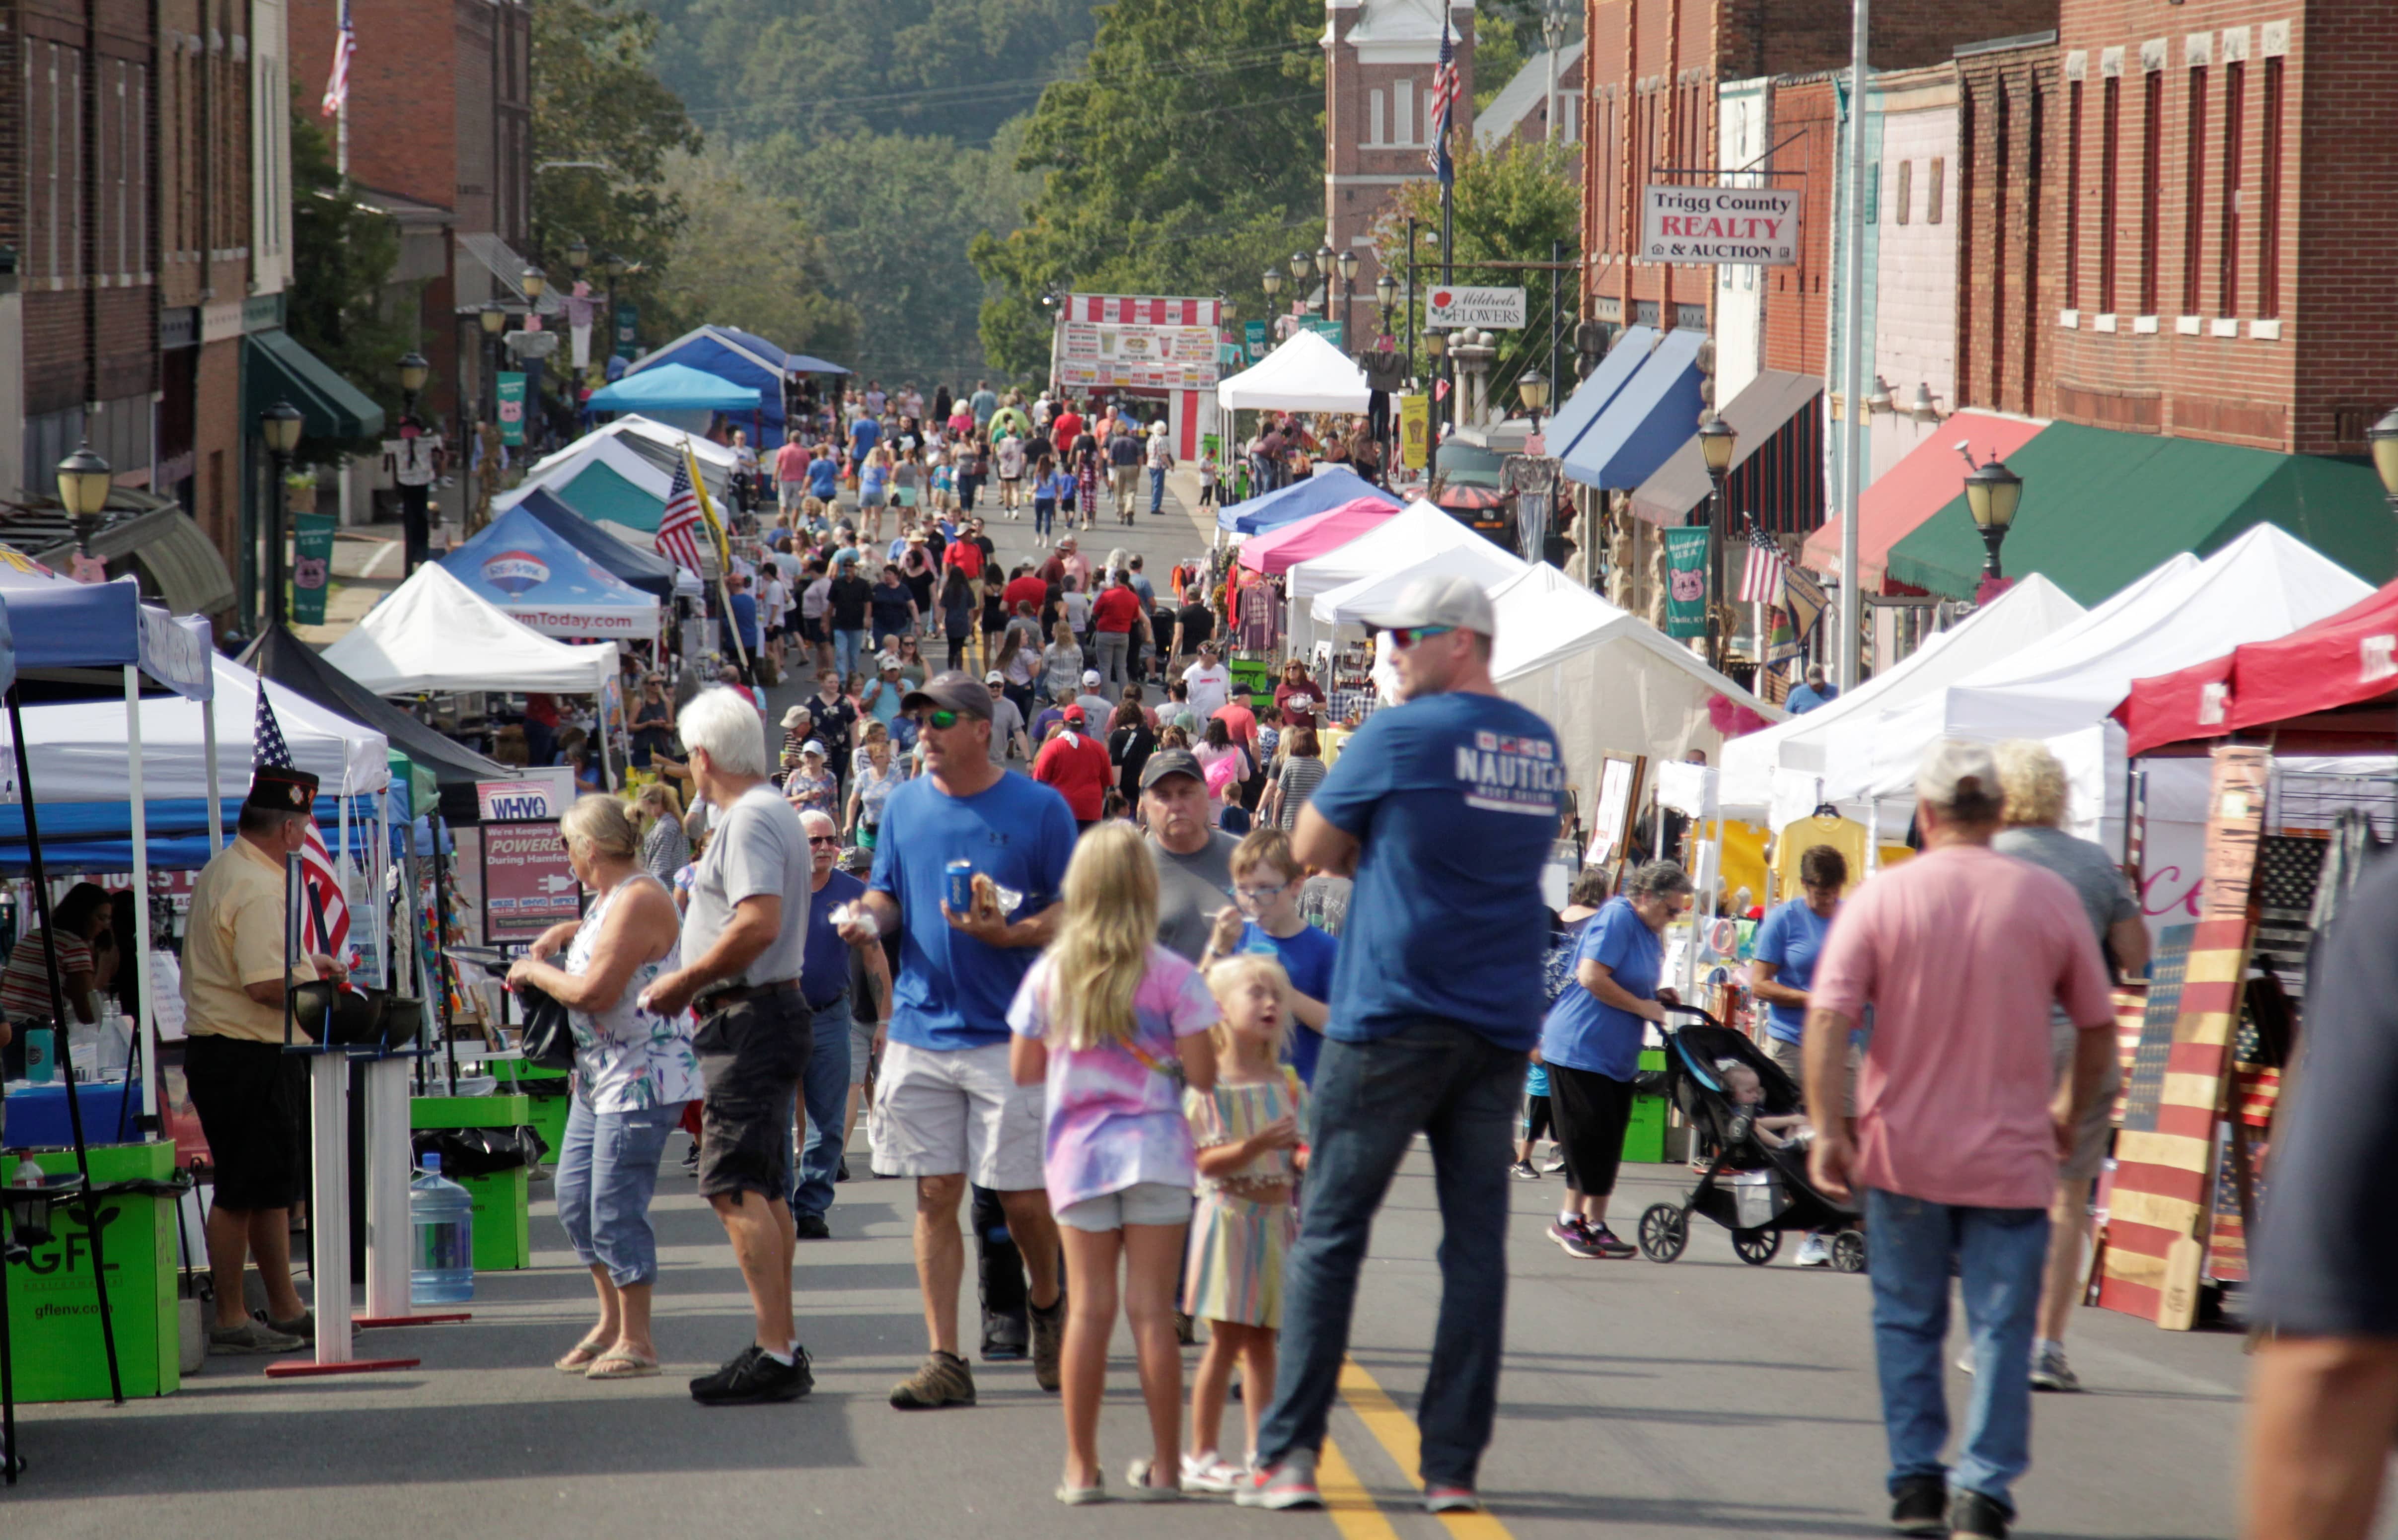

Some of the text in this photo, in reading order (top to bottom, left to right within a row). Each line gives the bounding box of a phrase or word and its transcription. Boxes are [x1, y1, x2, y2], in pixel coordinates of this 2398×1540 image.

[1654, 192, 1791, 215] Trigg County
[1661, 215, 1783, 239] REALTY
[1670, 243, 1686, 255] &
[1689, 243, 1771, 258] AUCTION
[1453, 308, 1520, 323] FLOWERS
[509, 612, 632, 629] rmToday.com
[491, 796, 547, 820] WHVO
[487, 828, 513, 837] We're
[515, 827, 553, 837] Keeping
[490, 838, 565, 853] POWERE
[487, 853, 570, 866] During Hamfes
[24, 1231, 120, 1275] GFL
